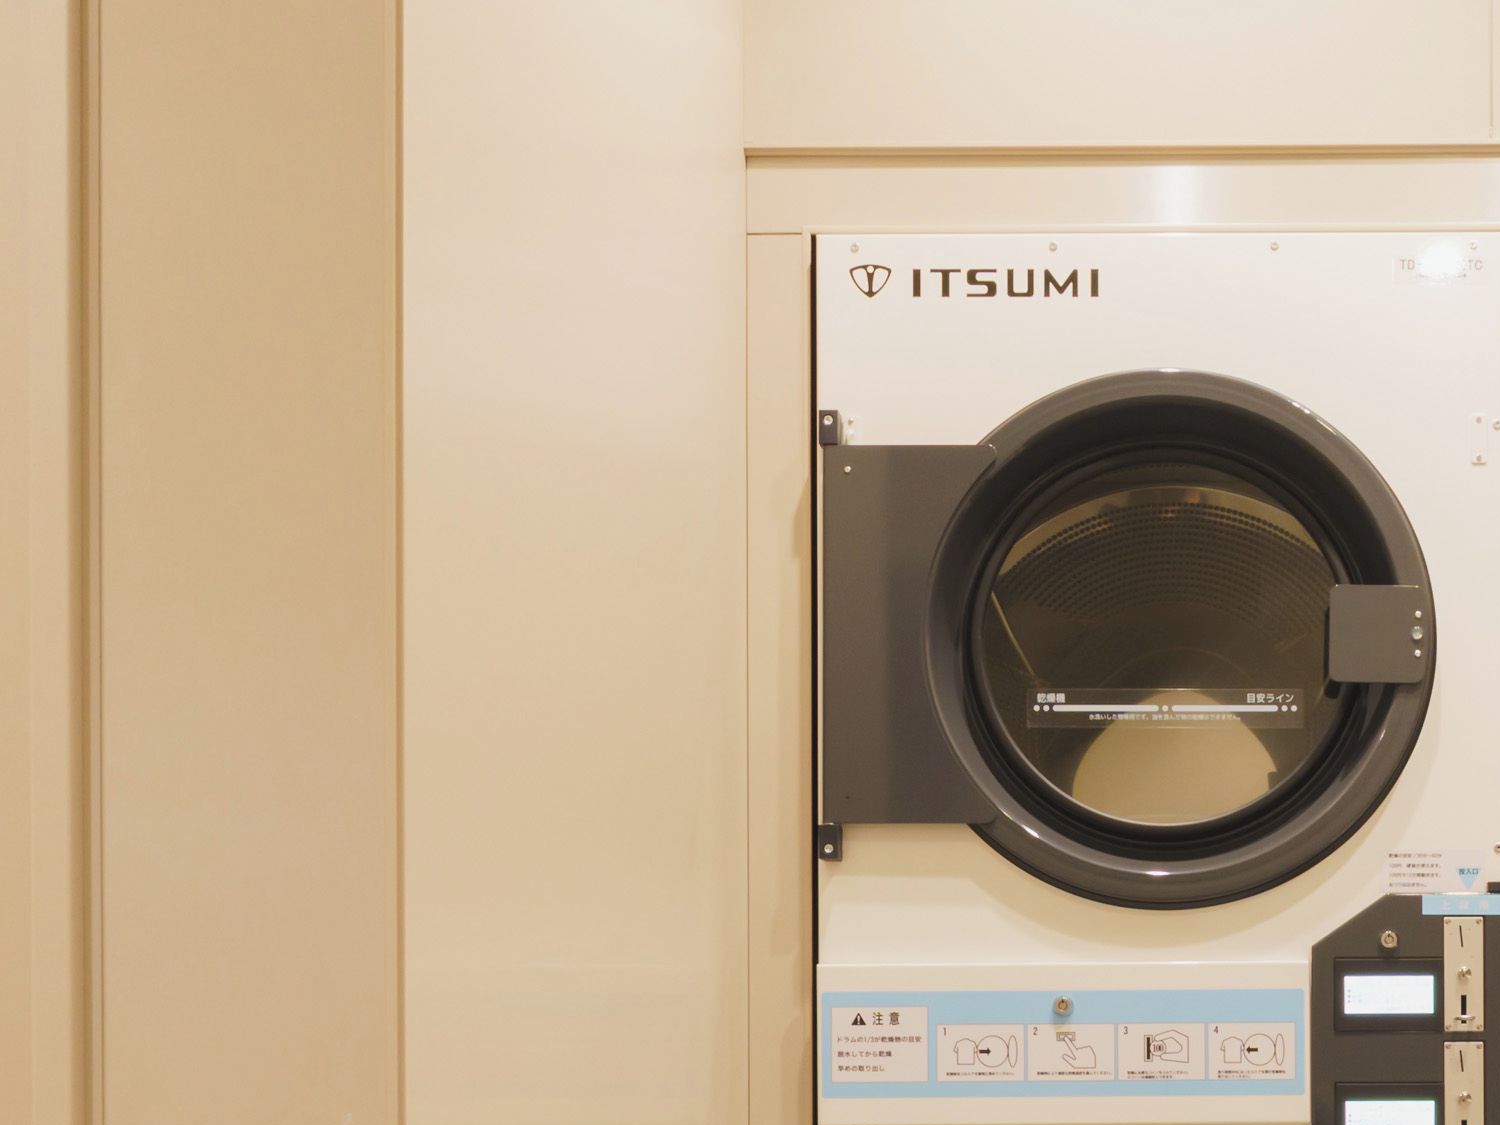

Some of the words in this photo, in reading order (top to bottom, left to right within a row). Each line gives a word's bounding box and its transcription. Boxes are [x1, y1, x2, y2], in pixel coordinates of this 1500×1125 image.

[912, 269, 1099, 297] ITSUMI
[1037, 693, 1065, 703] 乾燥機
[1247, 693, 1294, 703] 目安ライン
[872, 1012, 900, 1025] 注意
[943, 1028, 947, 1036] 1
[1033, 1027, 1038, 1035] 2
[1123, 1026, 1128, 1034] 3
[1213, 1026, 1218, 1034] 4
